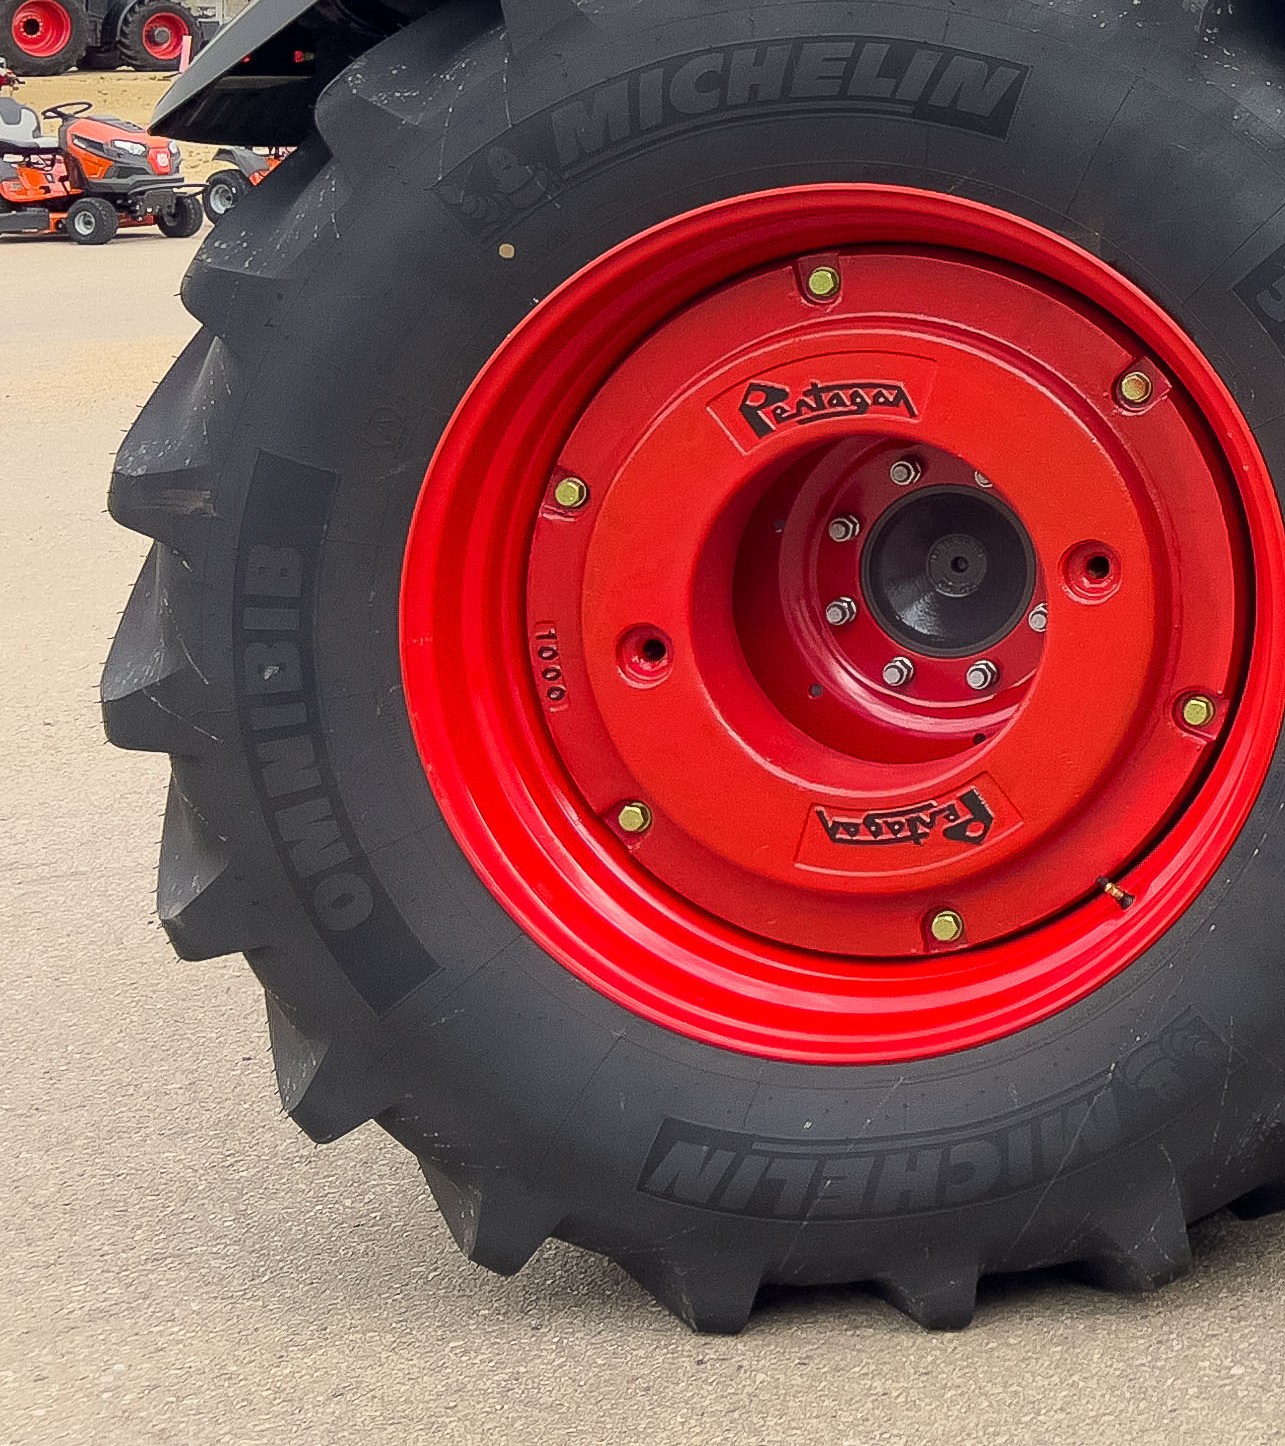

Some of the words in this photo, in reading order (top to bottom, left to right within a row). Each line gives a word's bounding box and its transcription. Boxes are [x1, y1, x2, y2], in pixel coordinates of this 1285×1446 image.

[550, 41, 1021, 168] MICHELIN
[535, 625, 567, 702] 1000
[242, 545, 375, 931] OMNIBIB
[650, 1084, 1122, 1214] MICHELIN
